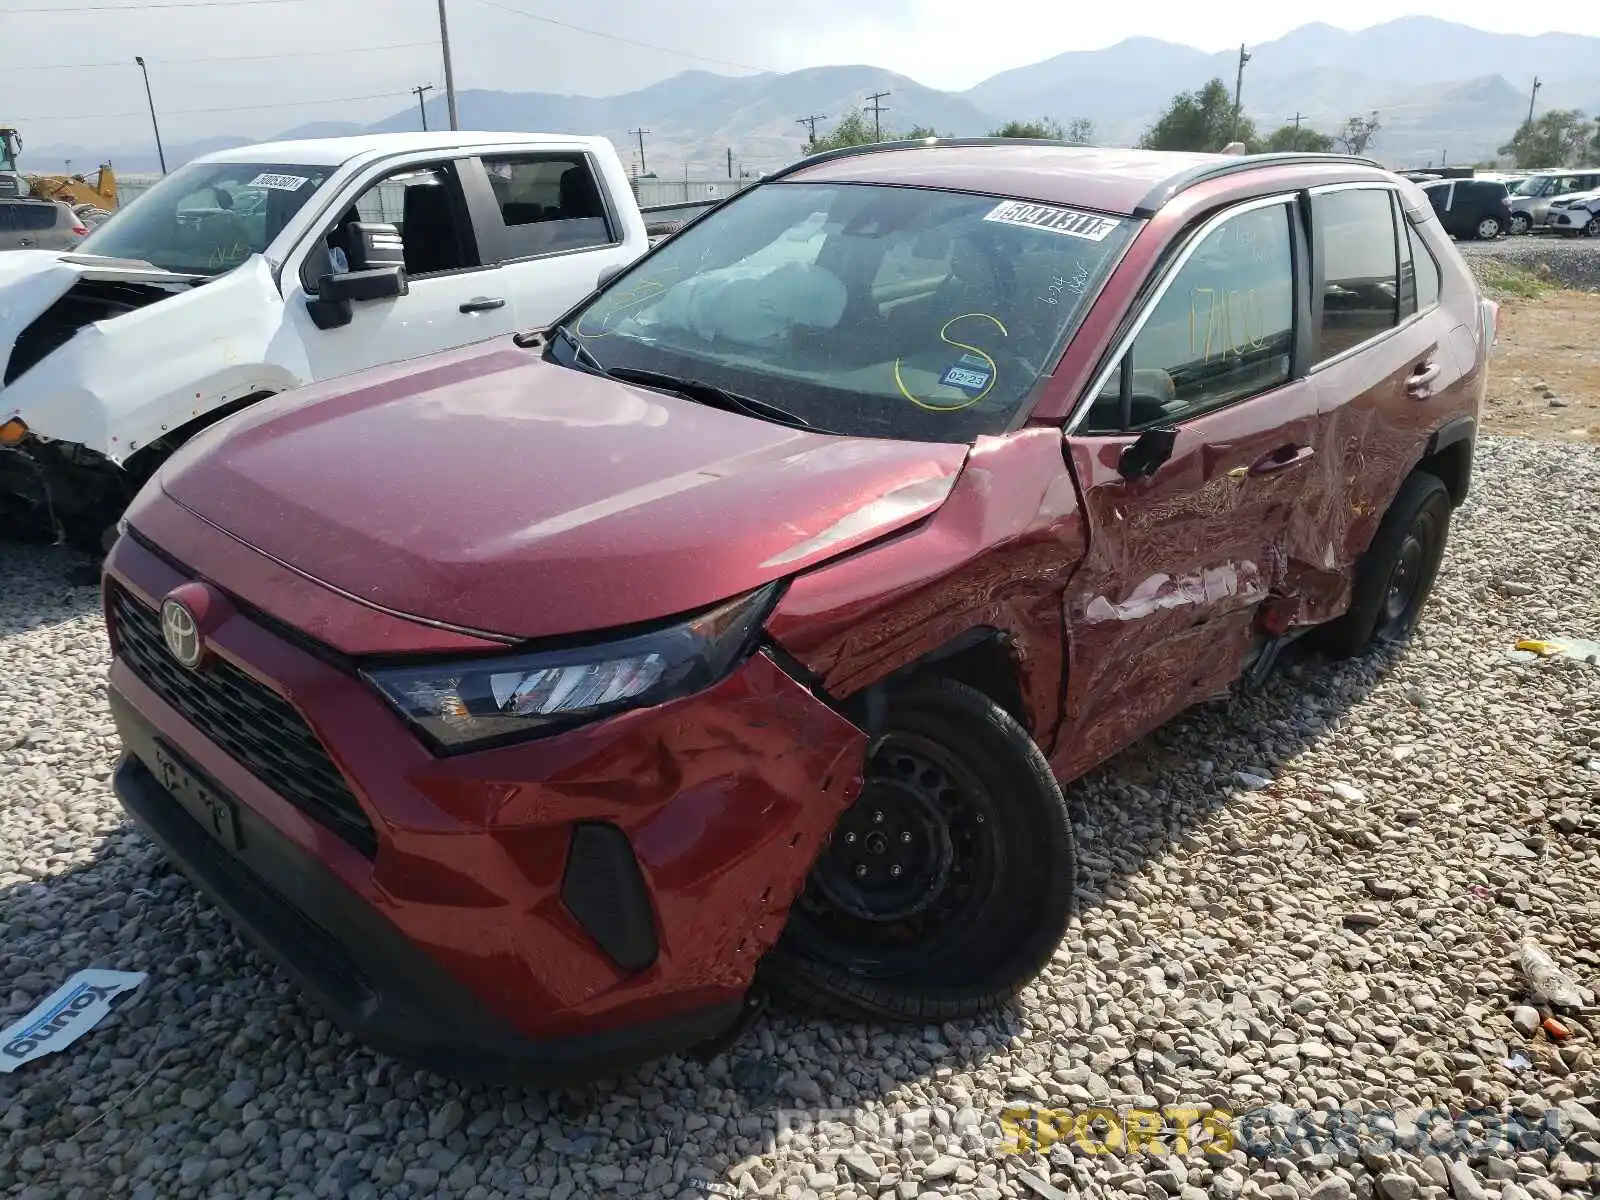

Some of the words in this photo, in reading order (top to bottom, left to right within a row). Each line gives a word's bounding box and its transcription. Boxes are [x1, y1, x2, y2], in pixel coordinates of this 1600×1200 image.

[1001, 203, 1098, 235] 50471311
[895, 313, 1008, 411] S
[2, 983, 121, 1059] Young
